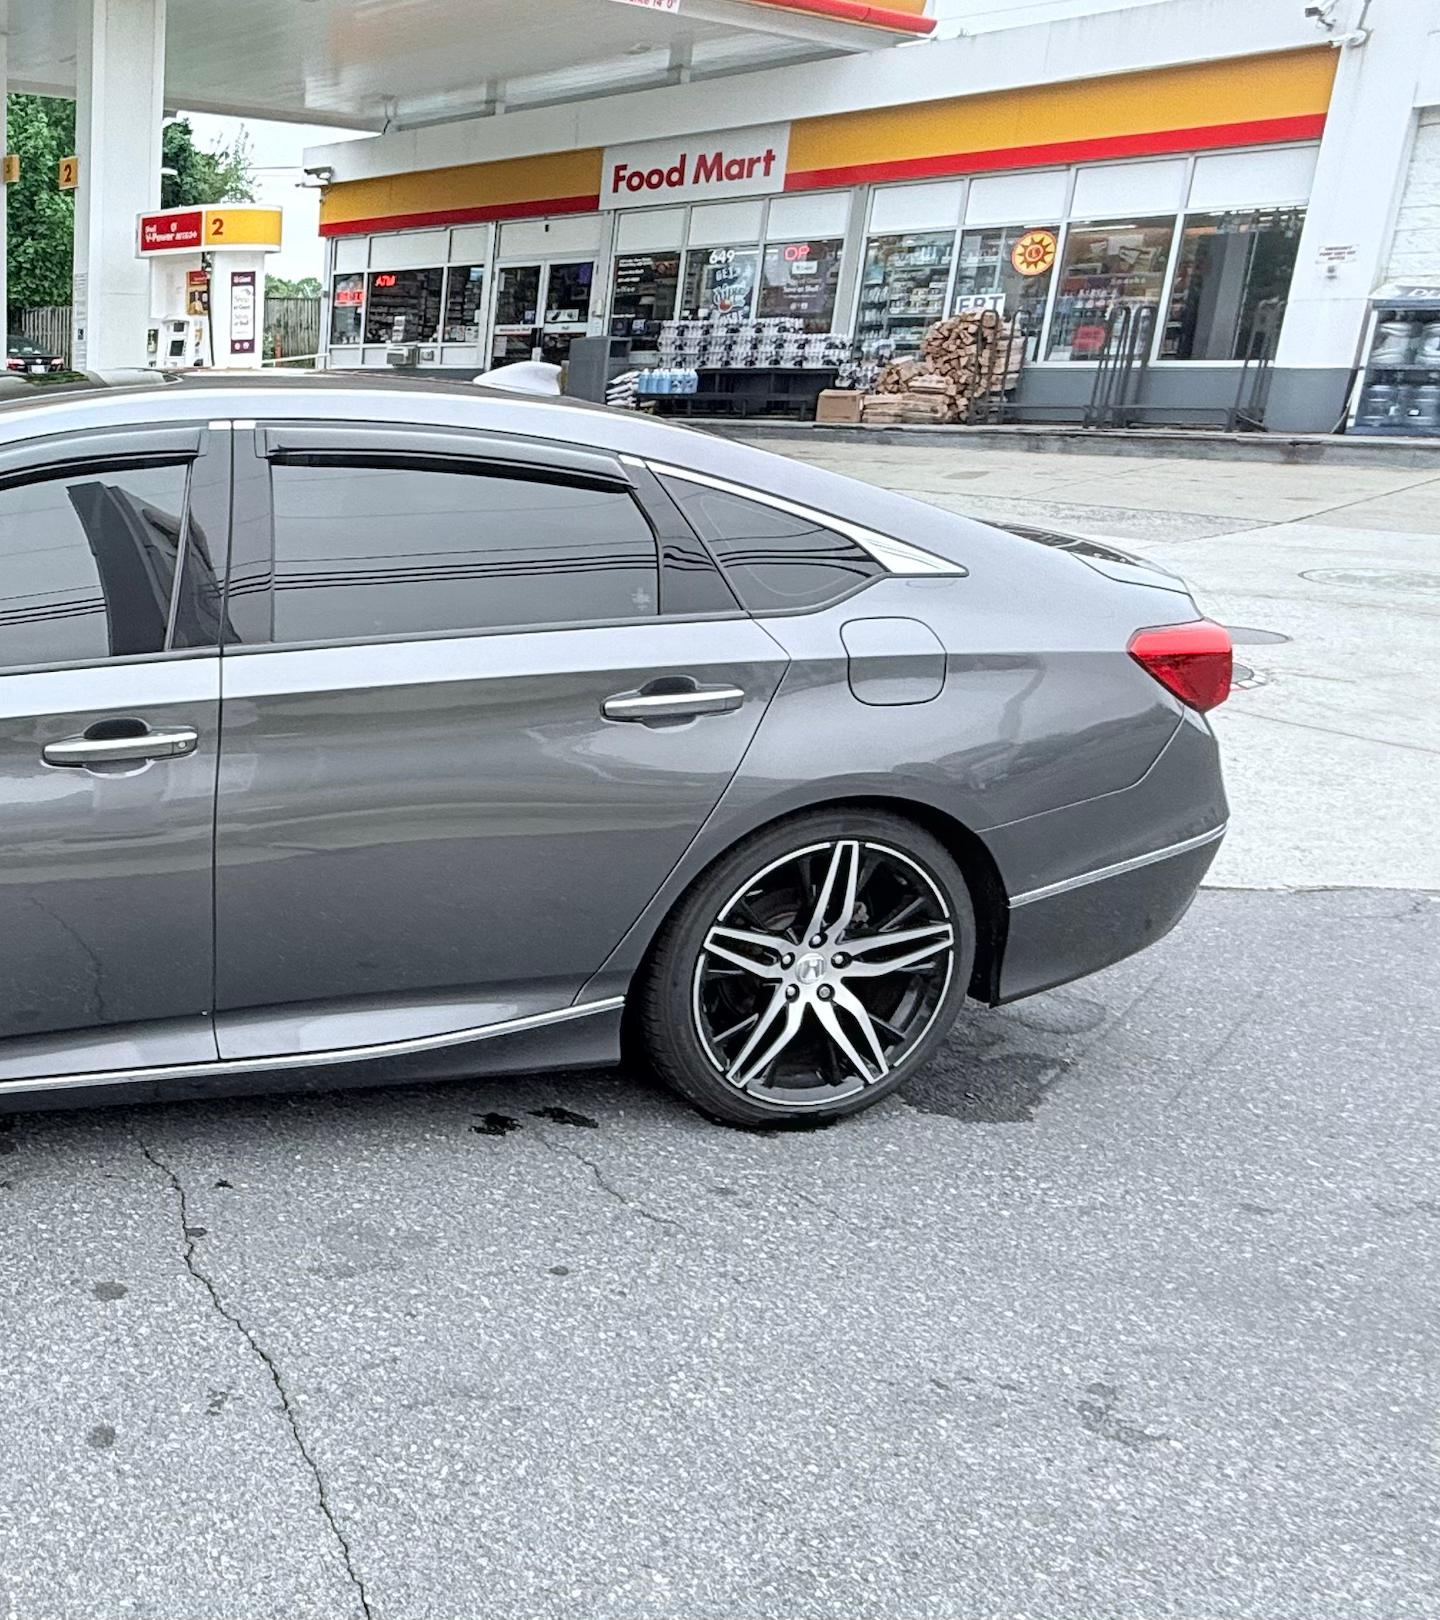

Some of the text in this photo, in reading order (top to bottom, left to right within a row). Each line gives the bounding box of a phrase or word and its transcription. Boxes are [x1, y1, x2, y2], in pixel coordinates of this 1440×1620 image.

[63, 163, 72, 182] 2
[613, 148, 776, 193] Food Mart
[211, 218, 224, 236] 2
[709, 249, 735, 264] 649
[375, 275, 396, 287] ATM
